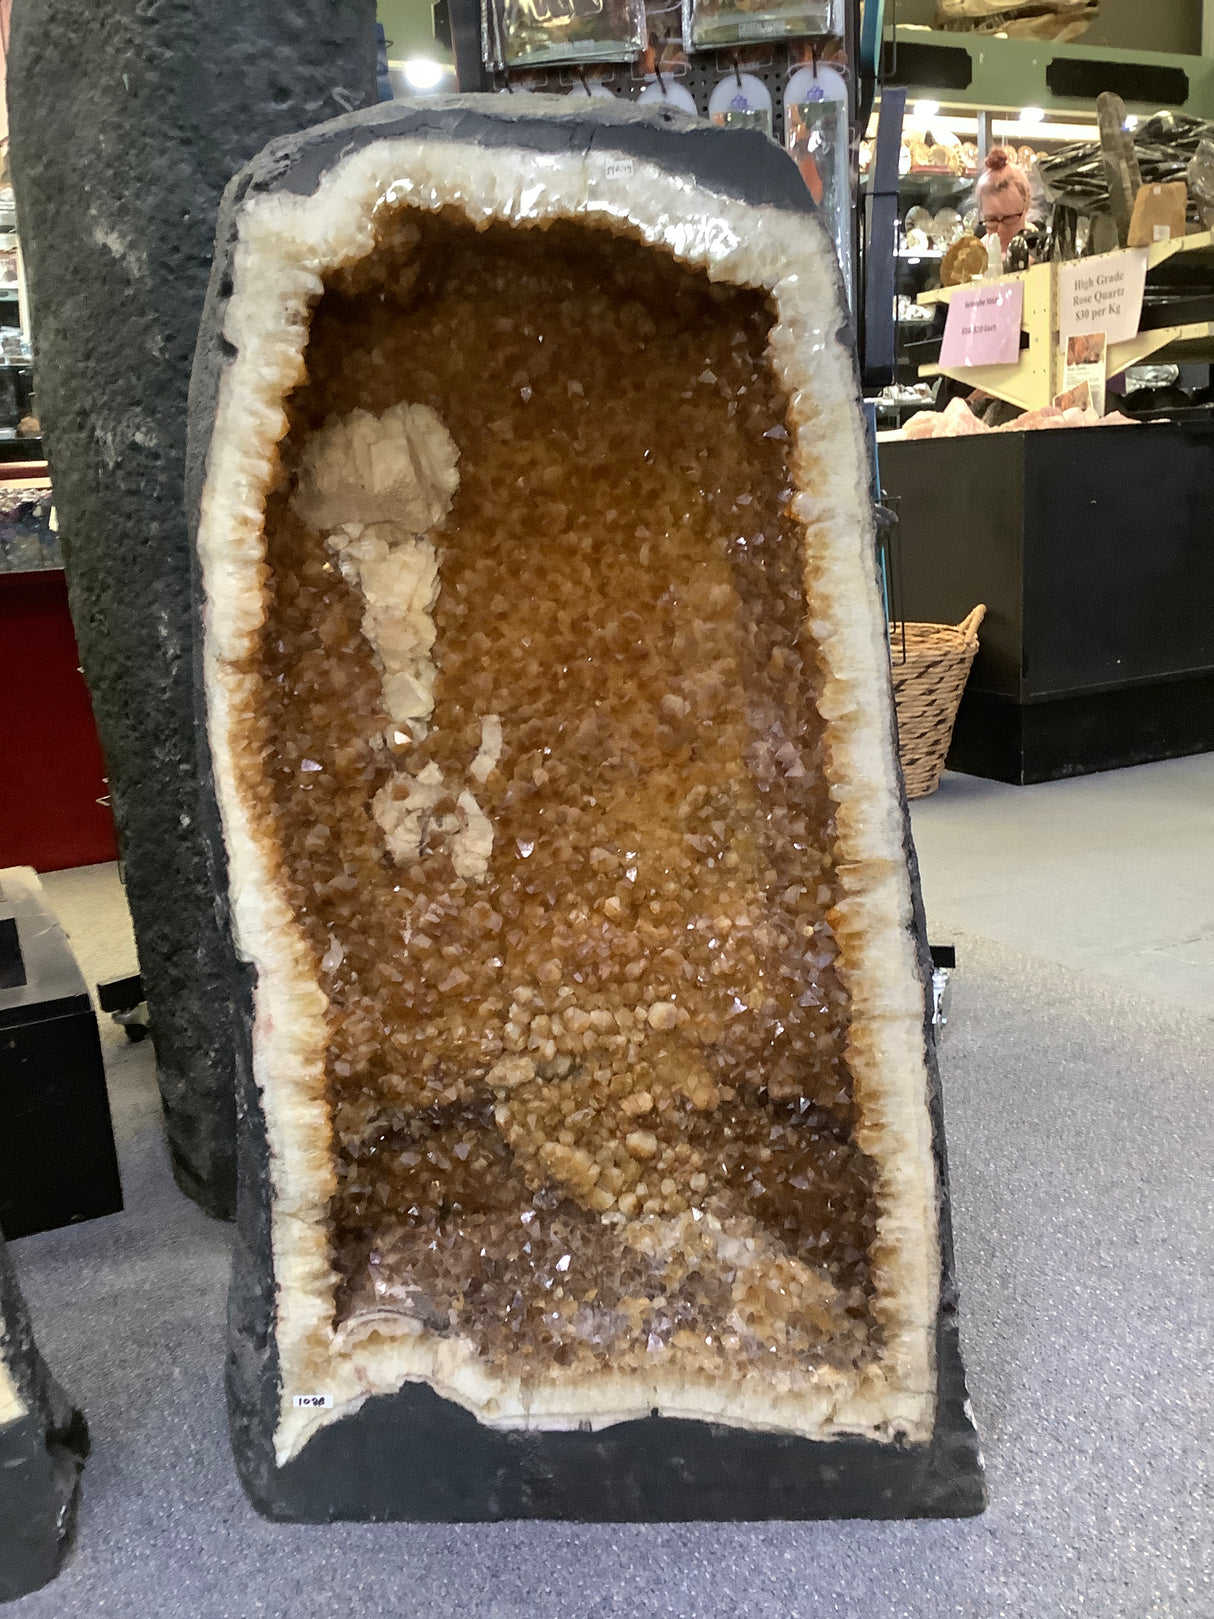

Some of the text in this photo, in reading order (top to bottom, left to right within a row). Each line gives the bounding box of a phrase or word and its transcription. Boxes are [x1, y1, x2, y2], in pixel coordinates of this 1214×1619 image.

[1074, 270, 1125, 291] High Grade
[1073, 287, 1125, 307] Rose Quartz
[1075, 303, 1121, 321] $30 per Kg
